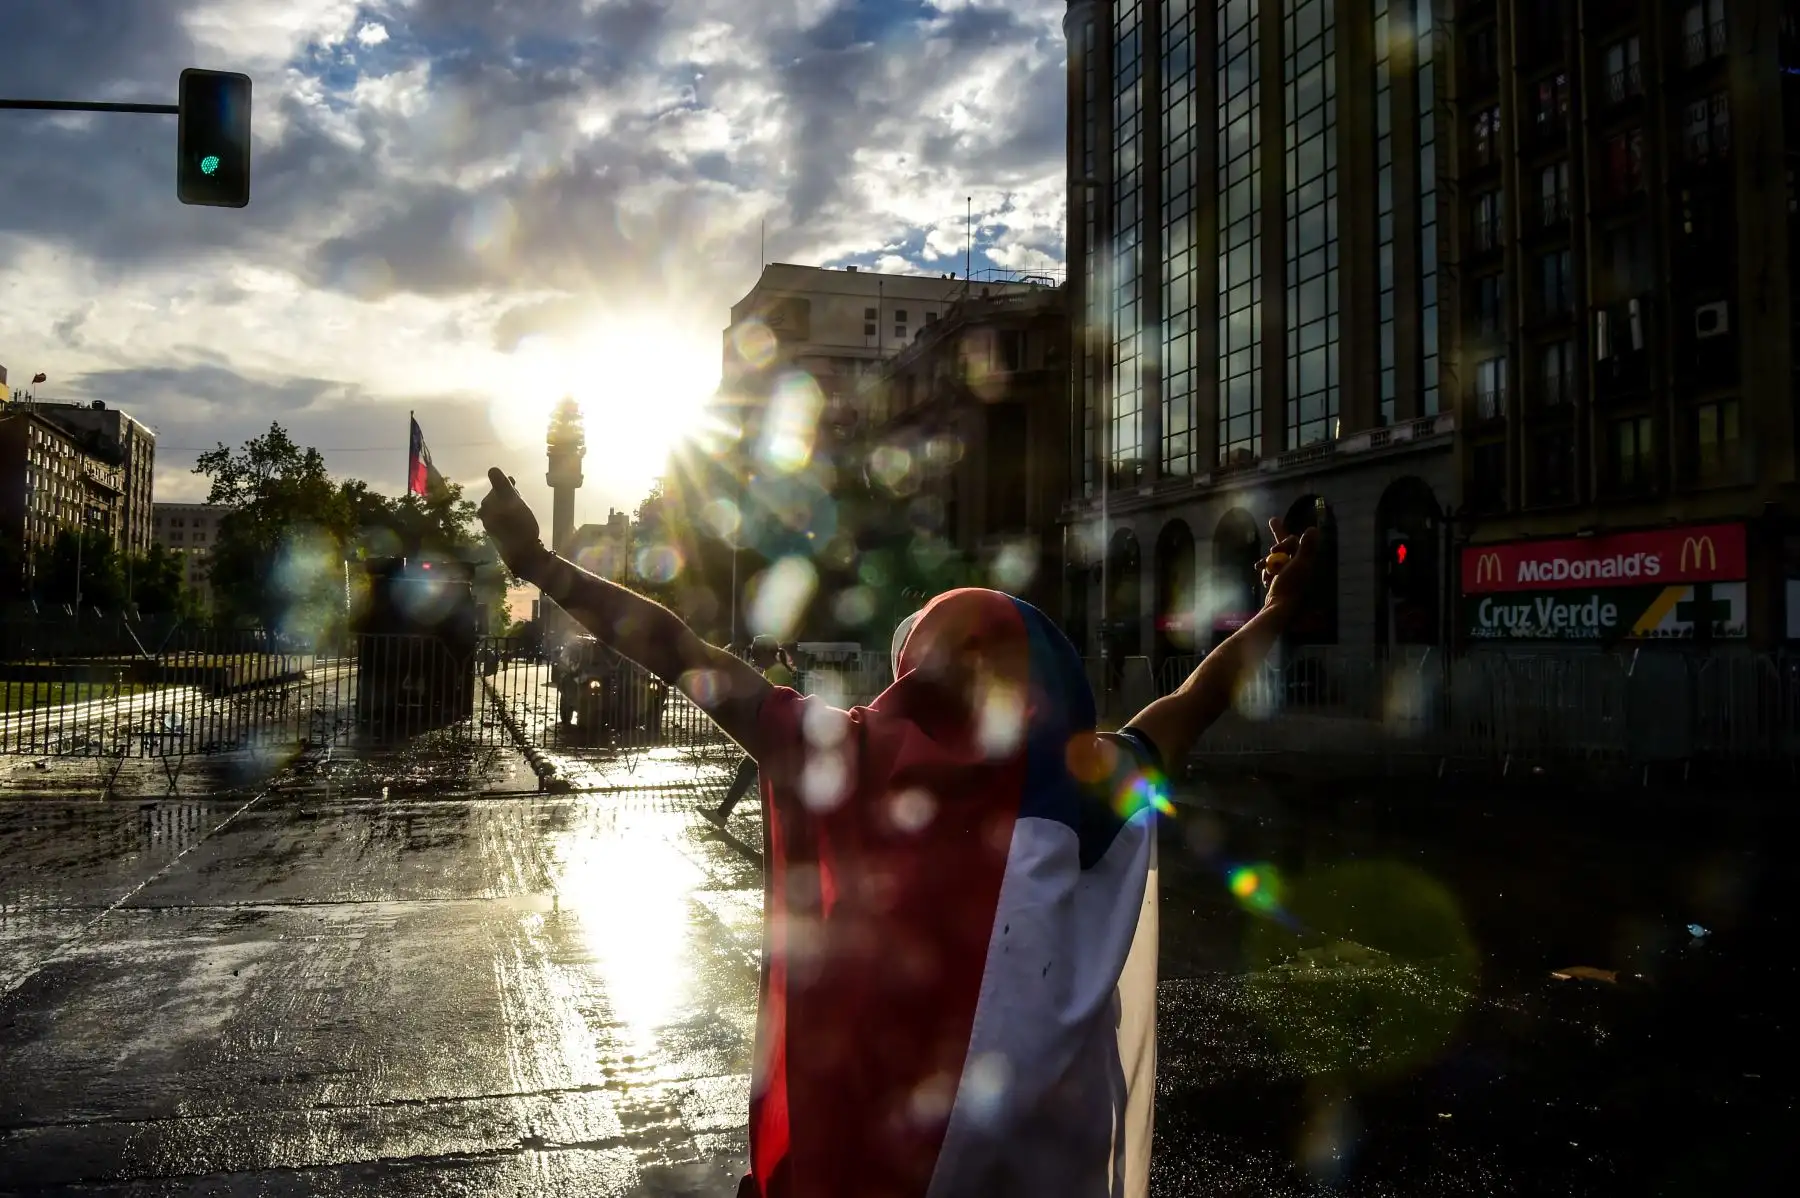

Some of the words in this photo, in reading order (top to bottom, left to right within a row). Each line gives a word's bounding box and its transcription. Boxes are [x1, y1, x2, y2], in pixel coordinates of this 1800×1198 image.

[1517, 553, 1660, 582] McDonald's
[1478, 597, 1532, 628] Cruz
[1533, 595, 1618, 629] Verde
